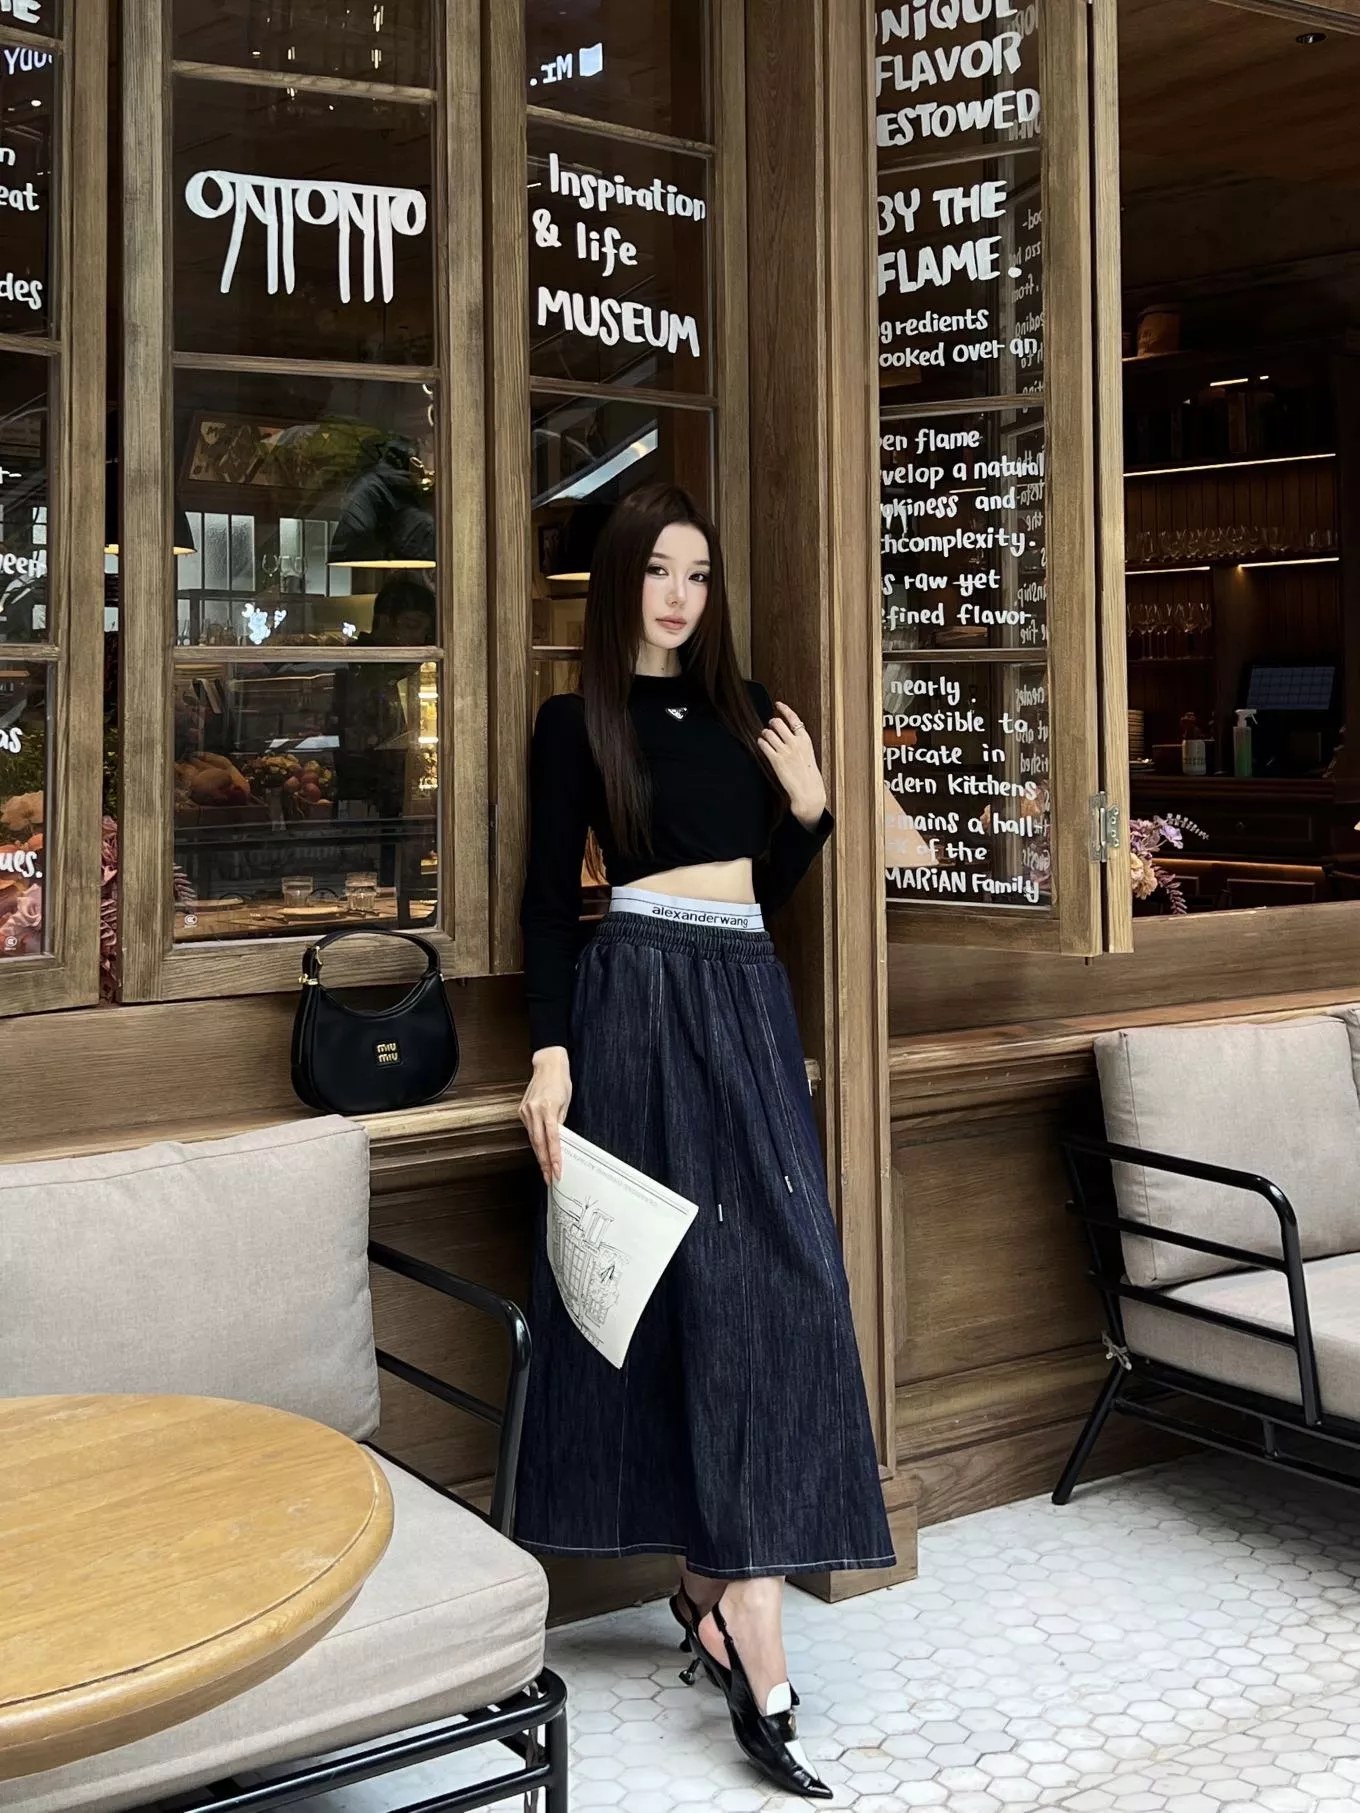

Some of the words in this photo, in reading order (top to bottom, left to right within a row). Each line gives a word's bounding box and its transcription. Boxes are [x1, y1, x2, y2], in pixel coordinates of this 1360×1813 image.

[876, 31, 1022, 98] FLAVOR
[550, 153, 706, 222] Inspiration
[932, 180, 1008, 228] THE
[532, 208, 562, 248] &
[576, 221, 638, 277] life
[537, 286, 700, 358] MUSEUM
[952, 338, 1006, 363] over
[1009, 337, 1038, 358] an
[914, 427, 982, 455] flame
[952, 461, 968, 481] a
[974, 485, 1016, 512] and
[903, 572, 949, 592] raw
[961, 568, 1000, 598] yet
[982, 743, 1006, 763] in
[947, 772, 1038, 802] kitchens
[967, 817, 985, 835] a
[945, 841, 988, 863] the
[651, 906, 749, 929] alexanderwang
[376, 1042, 397, 1053] miu
[378, 1052, 398, 1063] miu
